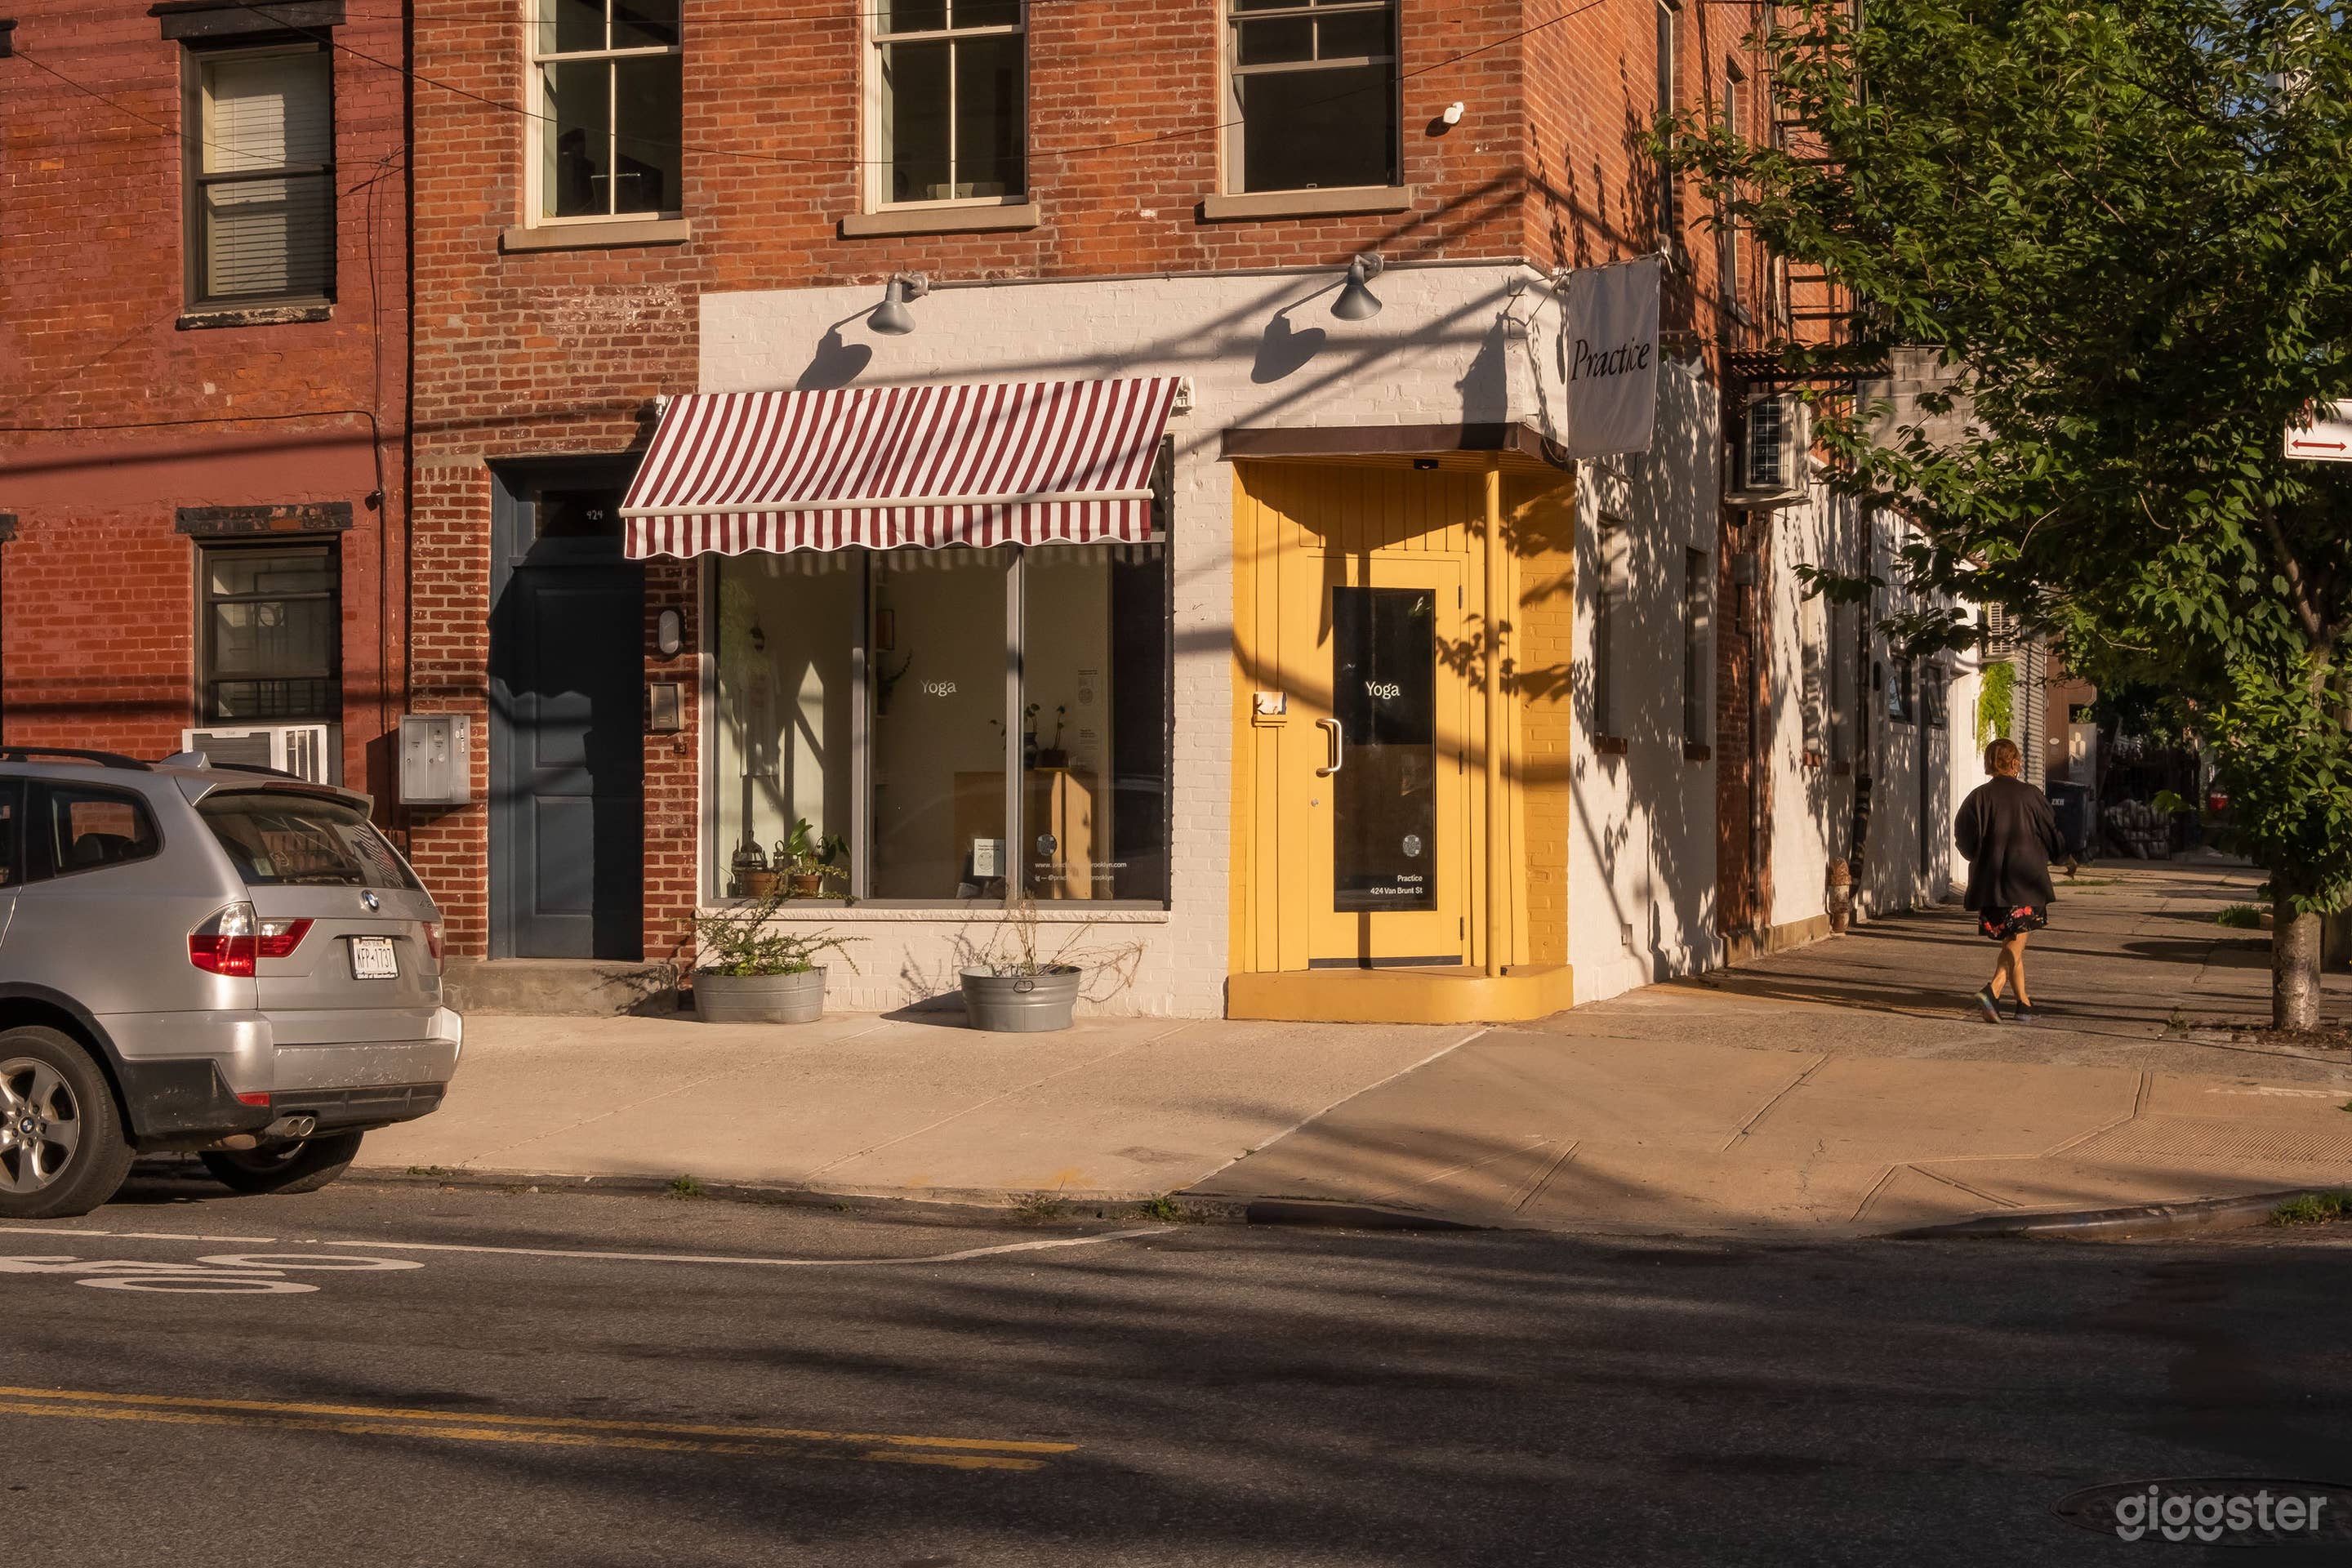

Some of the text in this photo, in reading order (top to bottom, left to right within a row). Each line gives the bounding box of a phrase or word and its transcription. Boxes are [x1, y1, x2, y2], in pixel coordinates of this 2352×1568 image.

[1570, 336, 1650, 381] Practice
[586, 510, 604, 520] 424
[920, 679, 957, 697] Yoga
[1365, 680, 1401, 700] Yoga
[1397, 874, 1423, 882] Practice
[1370, 887, 1383, 895] 424
[1415, 886, 1423, 894] St
